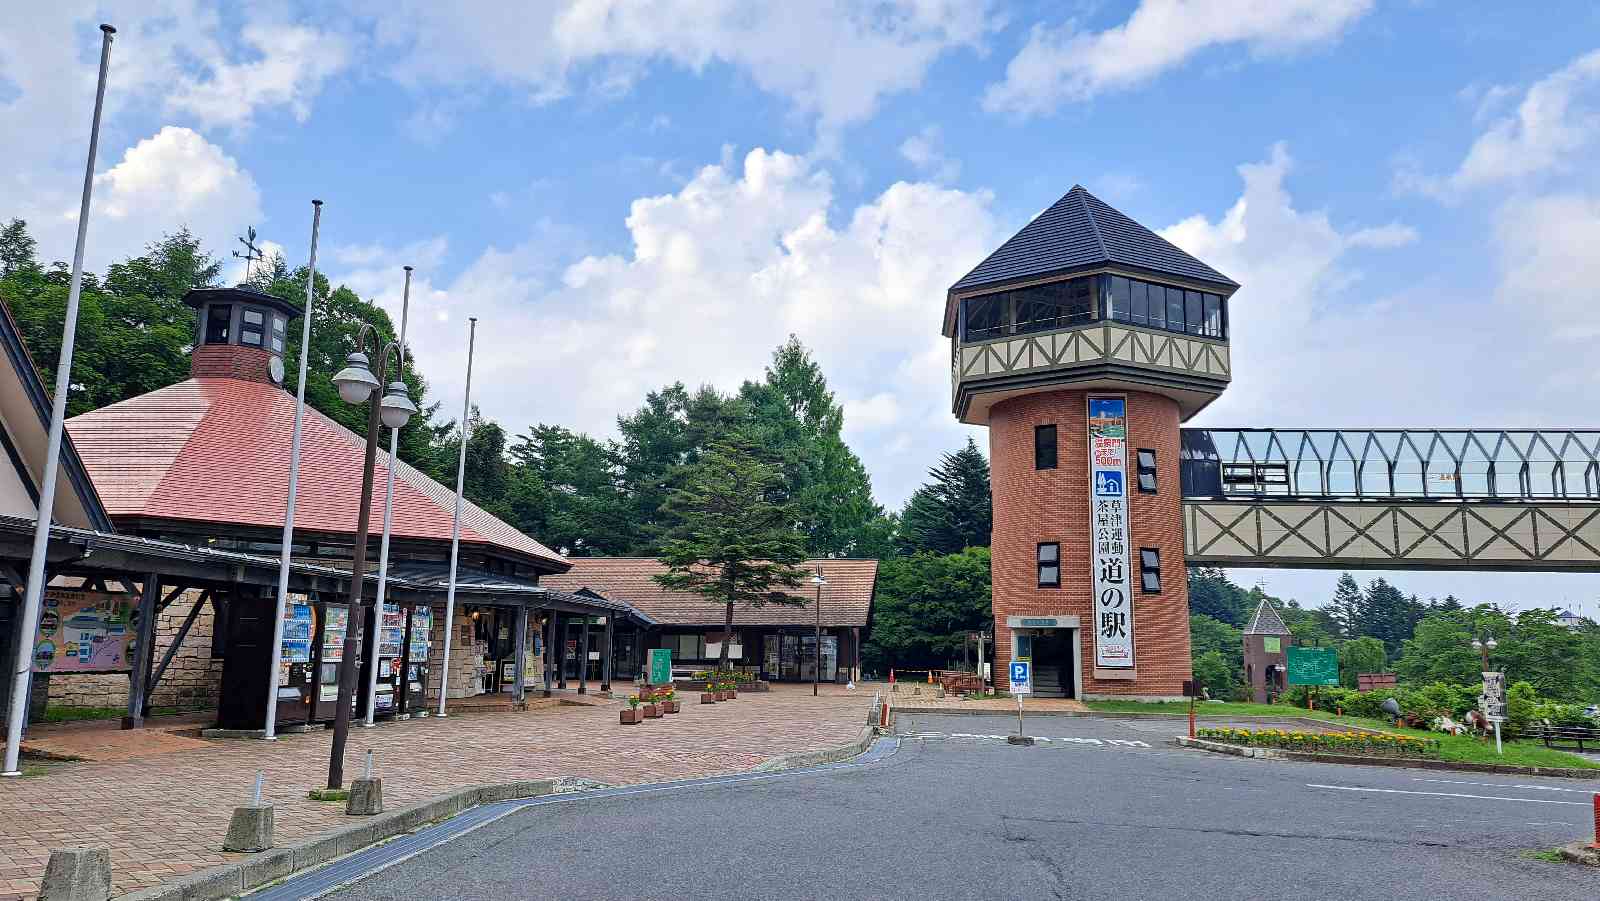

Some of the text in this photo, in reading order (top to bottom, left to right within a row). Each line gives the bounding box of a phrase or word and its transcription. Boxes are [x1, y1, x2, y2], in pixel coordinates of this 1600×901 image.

[1096, 456, 1121, 466] 500m
[1096, 499, 1109, 555] 茶屋公園
[1110, 499, 1123, 555] 草津運動
[1100, 557, 1126, 639] 道の駅
[1014, 665, 1025, 680] P
